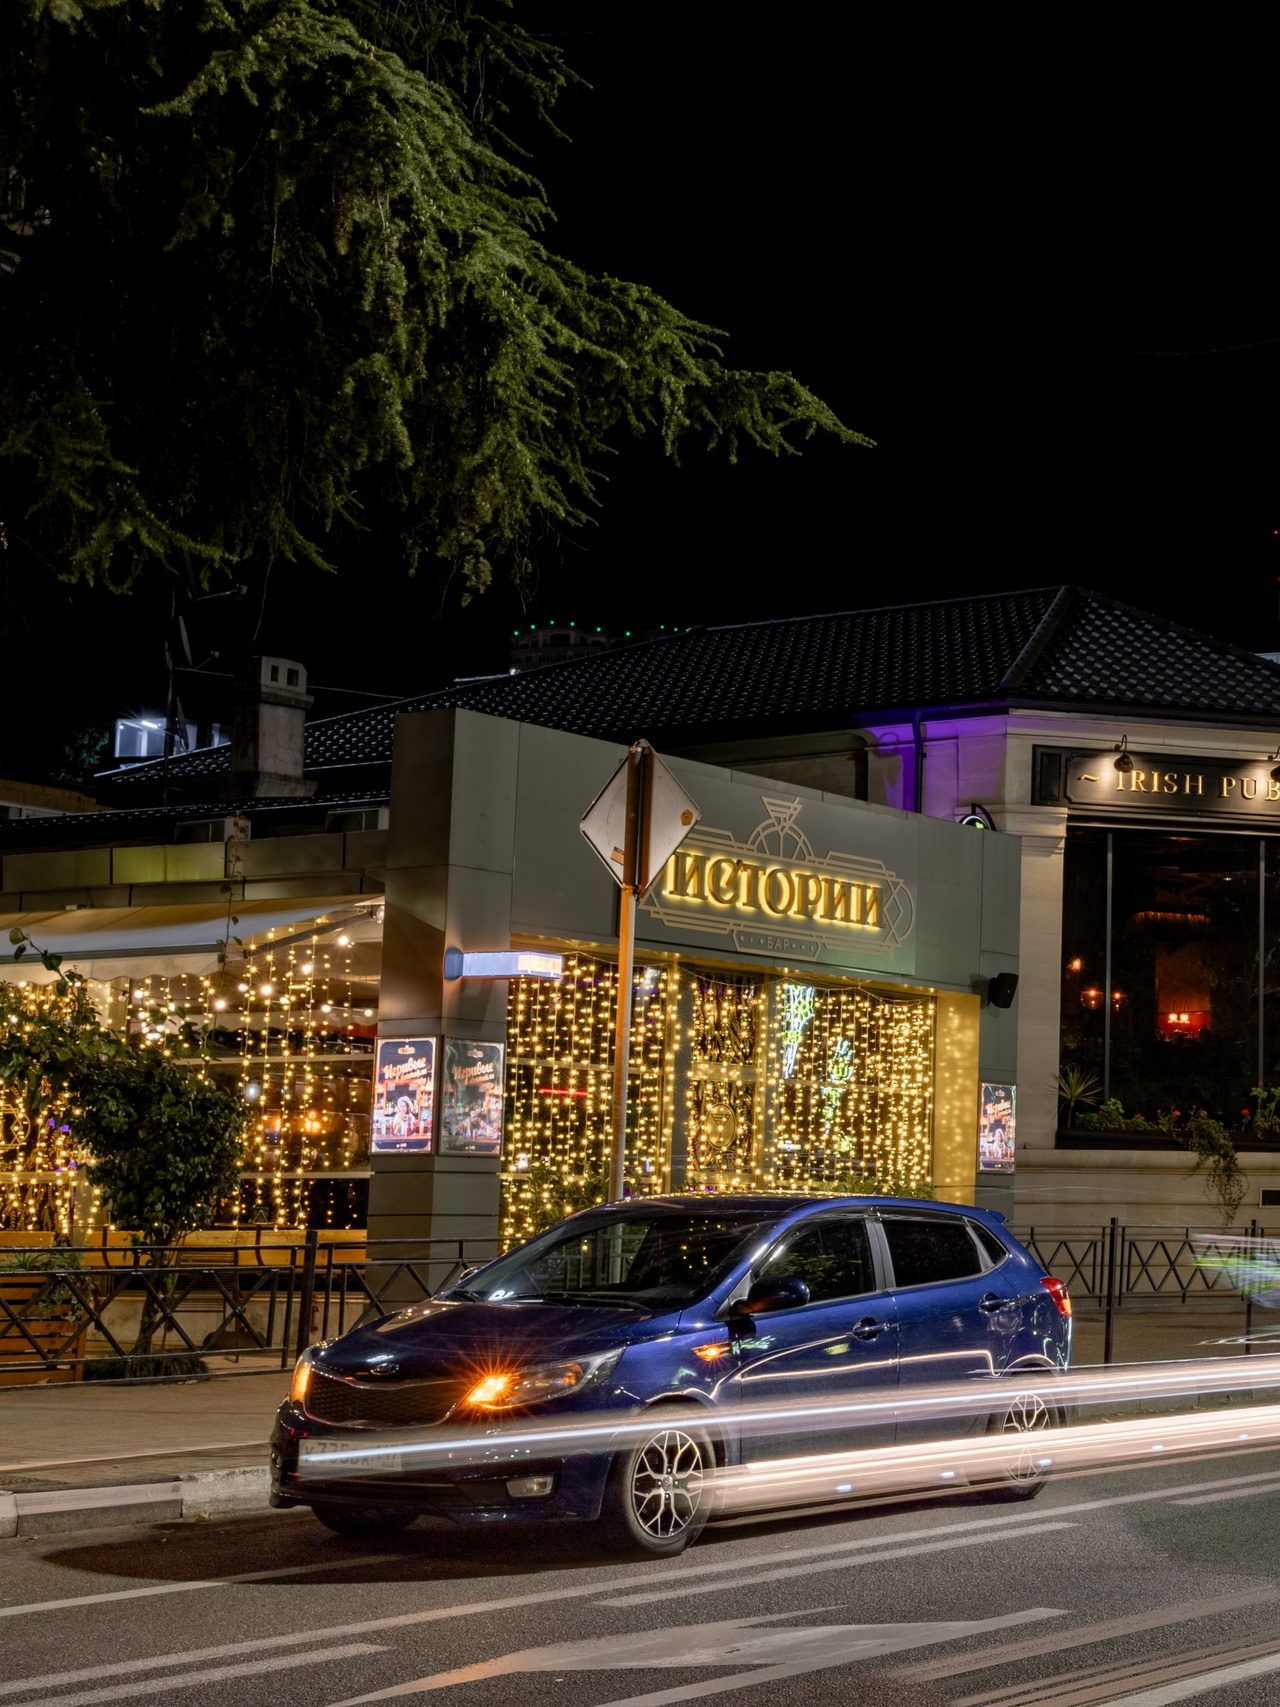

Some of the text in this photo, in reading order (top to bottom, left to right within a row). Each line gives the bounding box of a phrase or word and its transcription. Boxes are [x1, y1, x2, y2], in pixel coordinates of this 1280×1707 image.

[1116, 769, 1204, 795] IRISH
[667, 851, 888, 929] ИСТОРИИ
[766, 932, 790, 950] БАР
